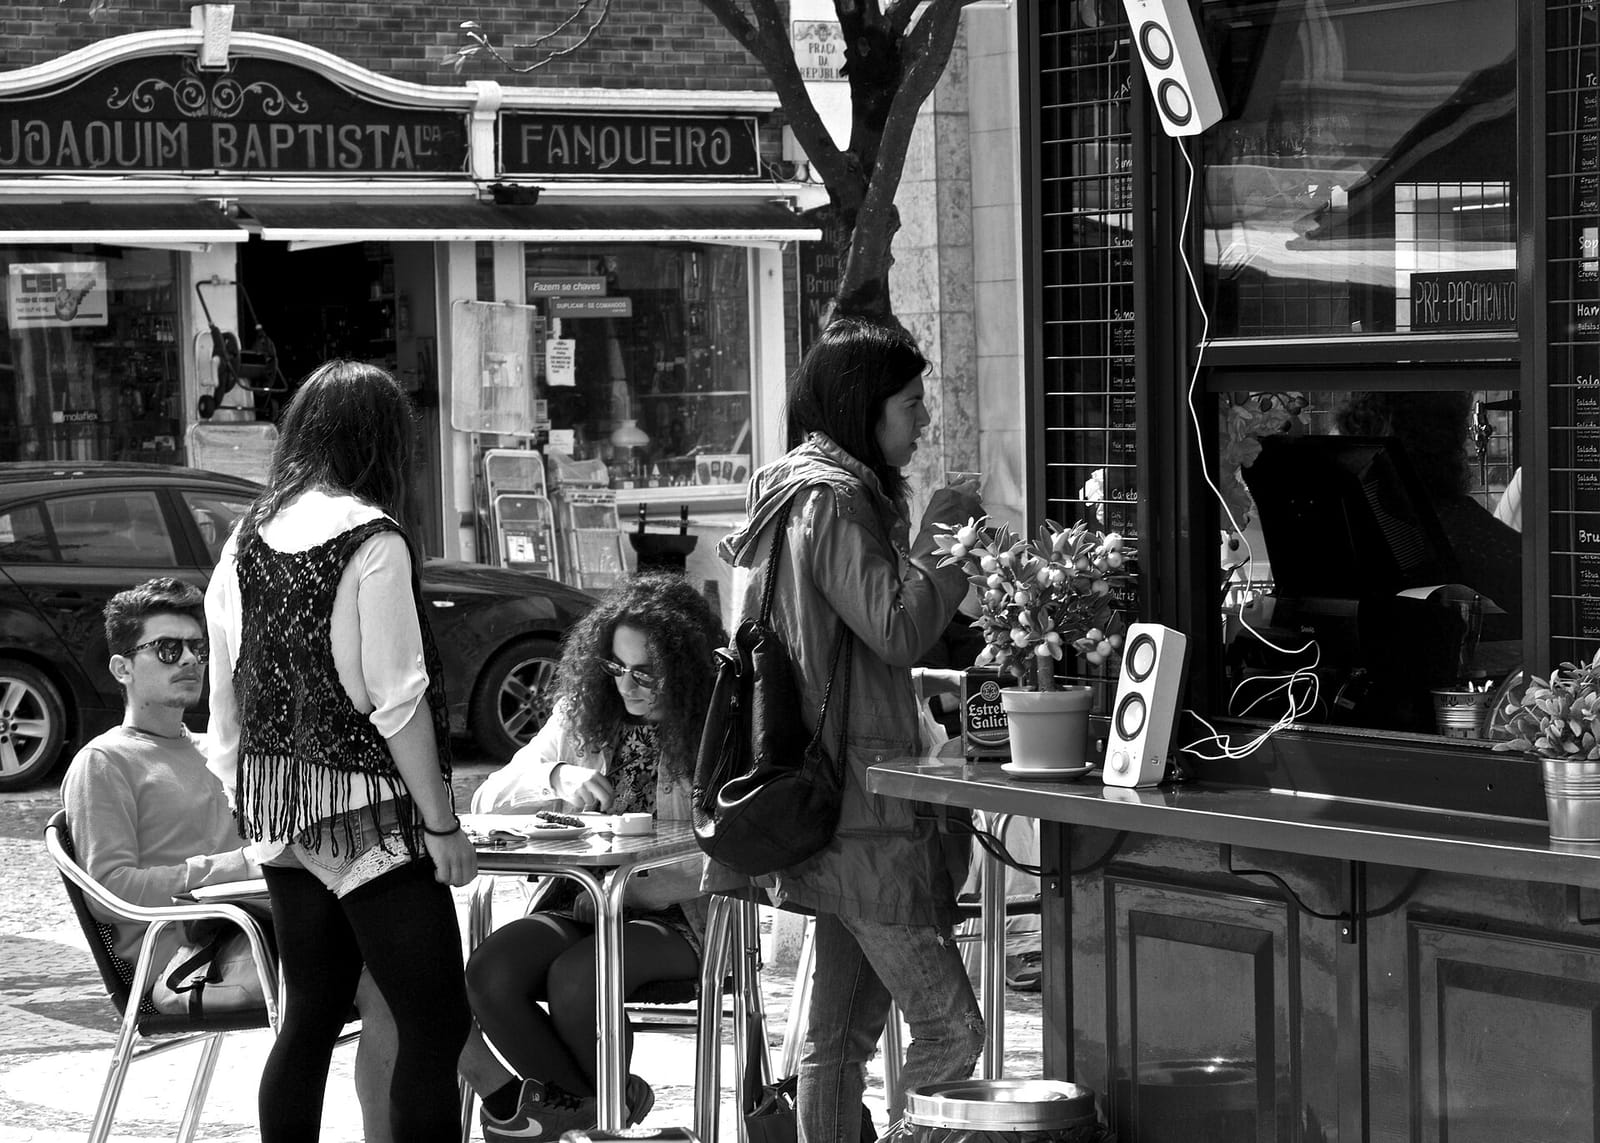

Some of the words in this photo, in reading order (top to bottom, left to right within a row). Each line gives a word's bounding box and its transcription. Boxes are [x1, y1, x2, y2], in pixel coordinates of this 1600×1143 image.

[0, 119, 190, 168] JOAQUIM
[212, 122, 415, 169] BAPTISTA
[520, 123, 732, 170] FANQUEIRO
[533, 282, 560, 291] Fazem
[561, 283, 571, 291] se
[572, 282, 601, 291] chaves
[971, 714, 1008, 729] Galici
